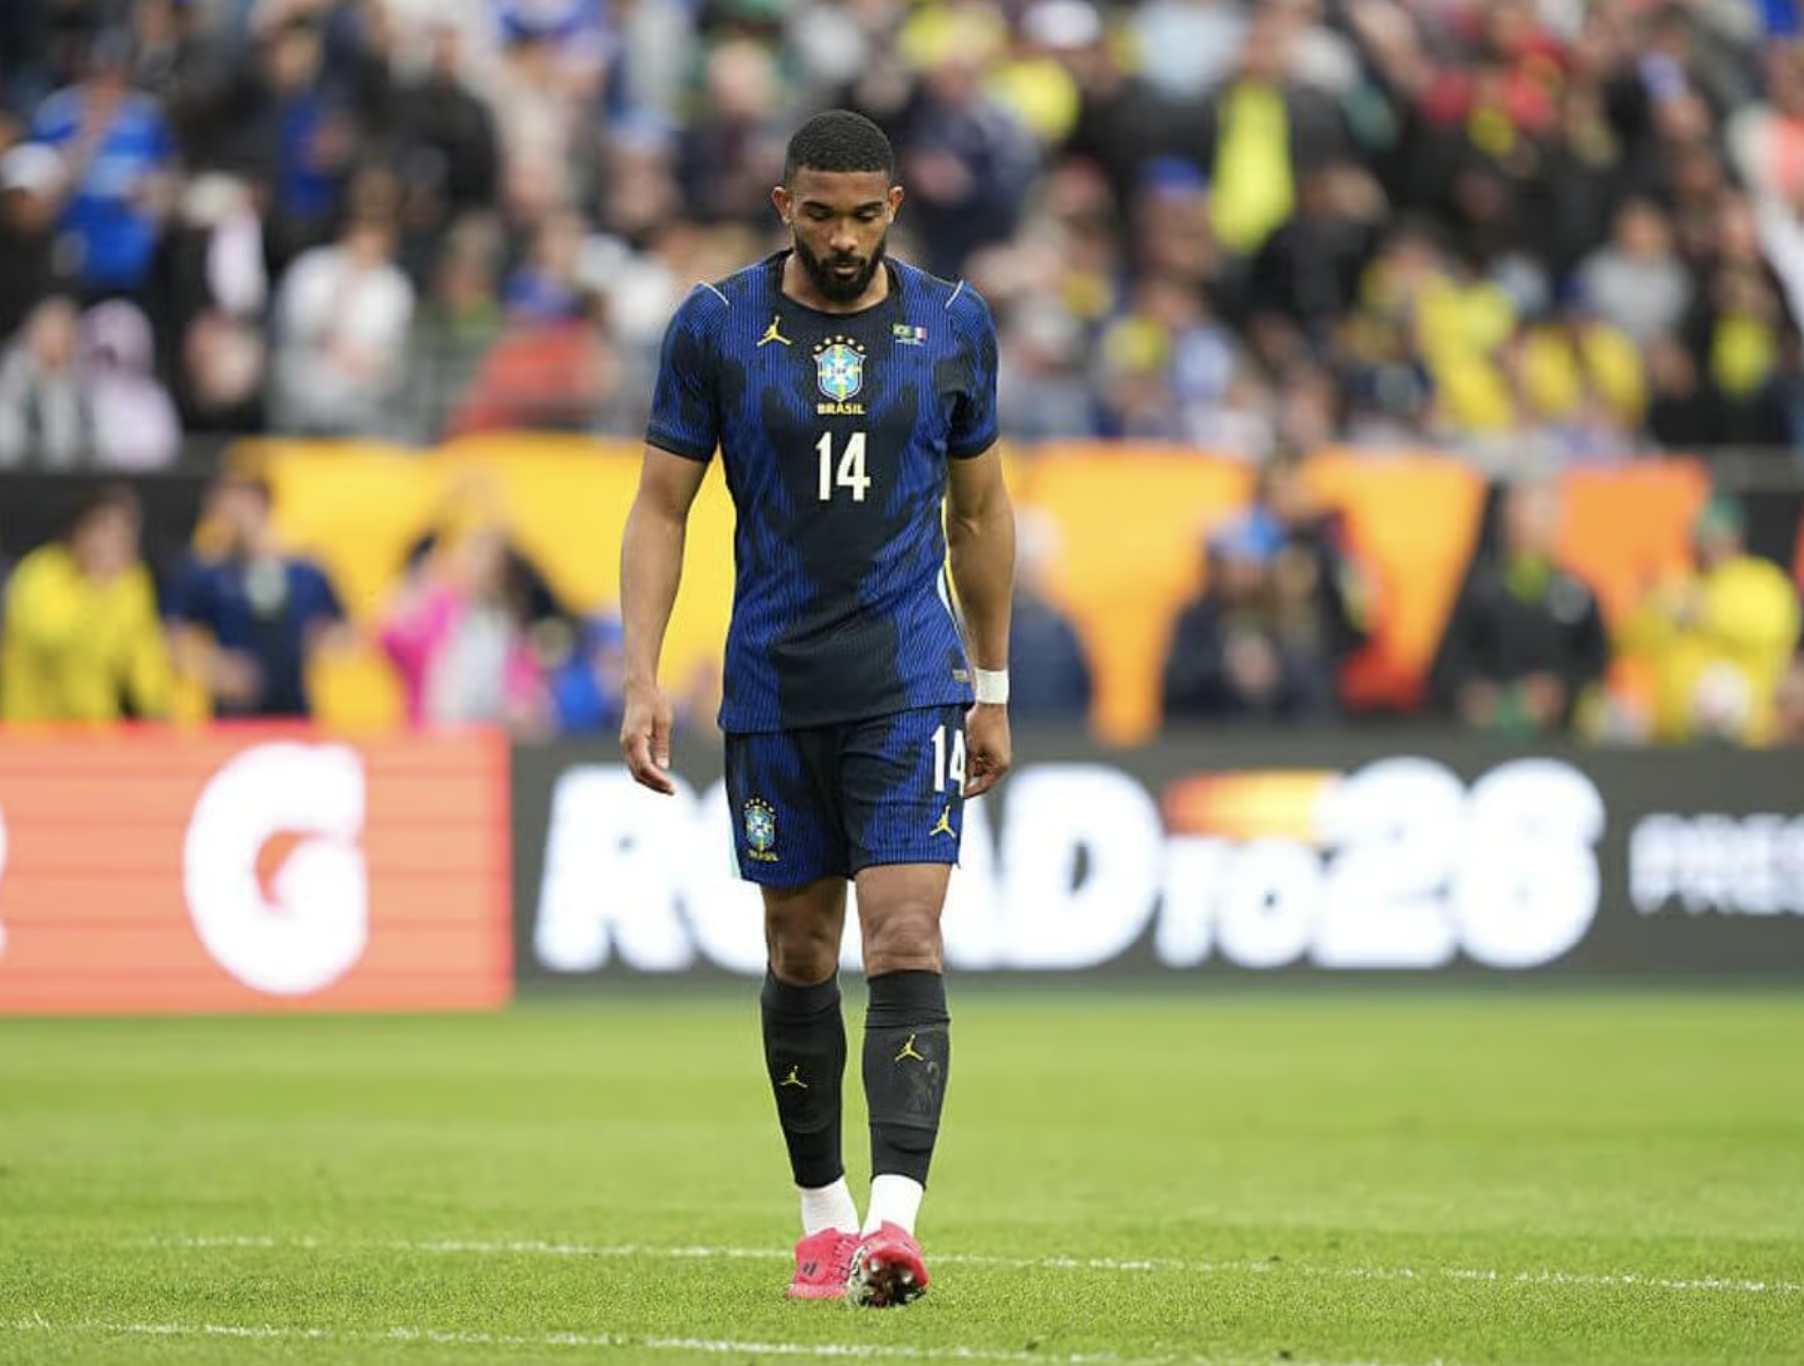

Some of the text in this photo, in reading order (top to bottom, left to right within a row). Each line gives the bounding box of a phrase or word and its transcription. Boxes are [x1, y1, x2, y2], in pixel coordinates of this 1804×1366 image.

[817, 402, 867, 415] BRASIL
[815, 431, 871, 501] 14
[931, 725, 966, 796] 14
[183, 739, 369, 995] G
[1309, 756, 1605, 968] 26
